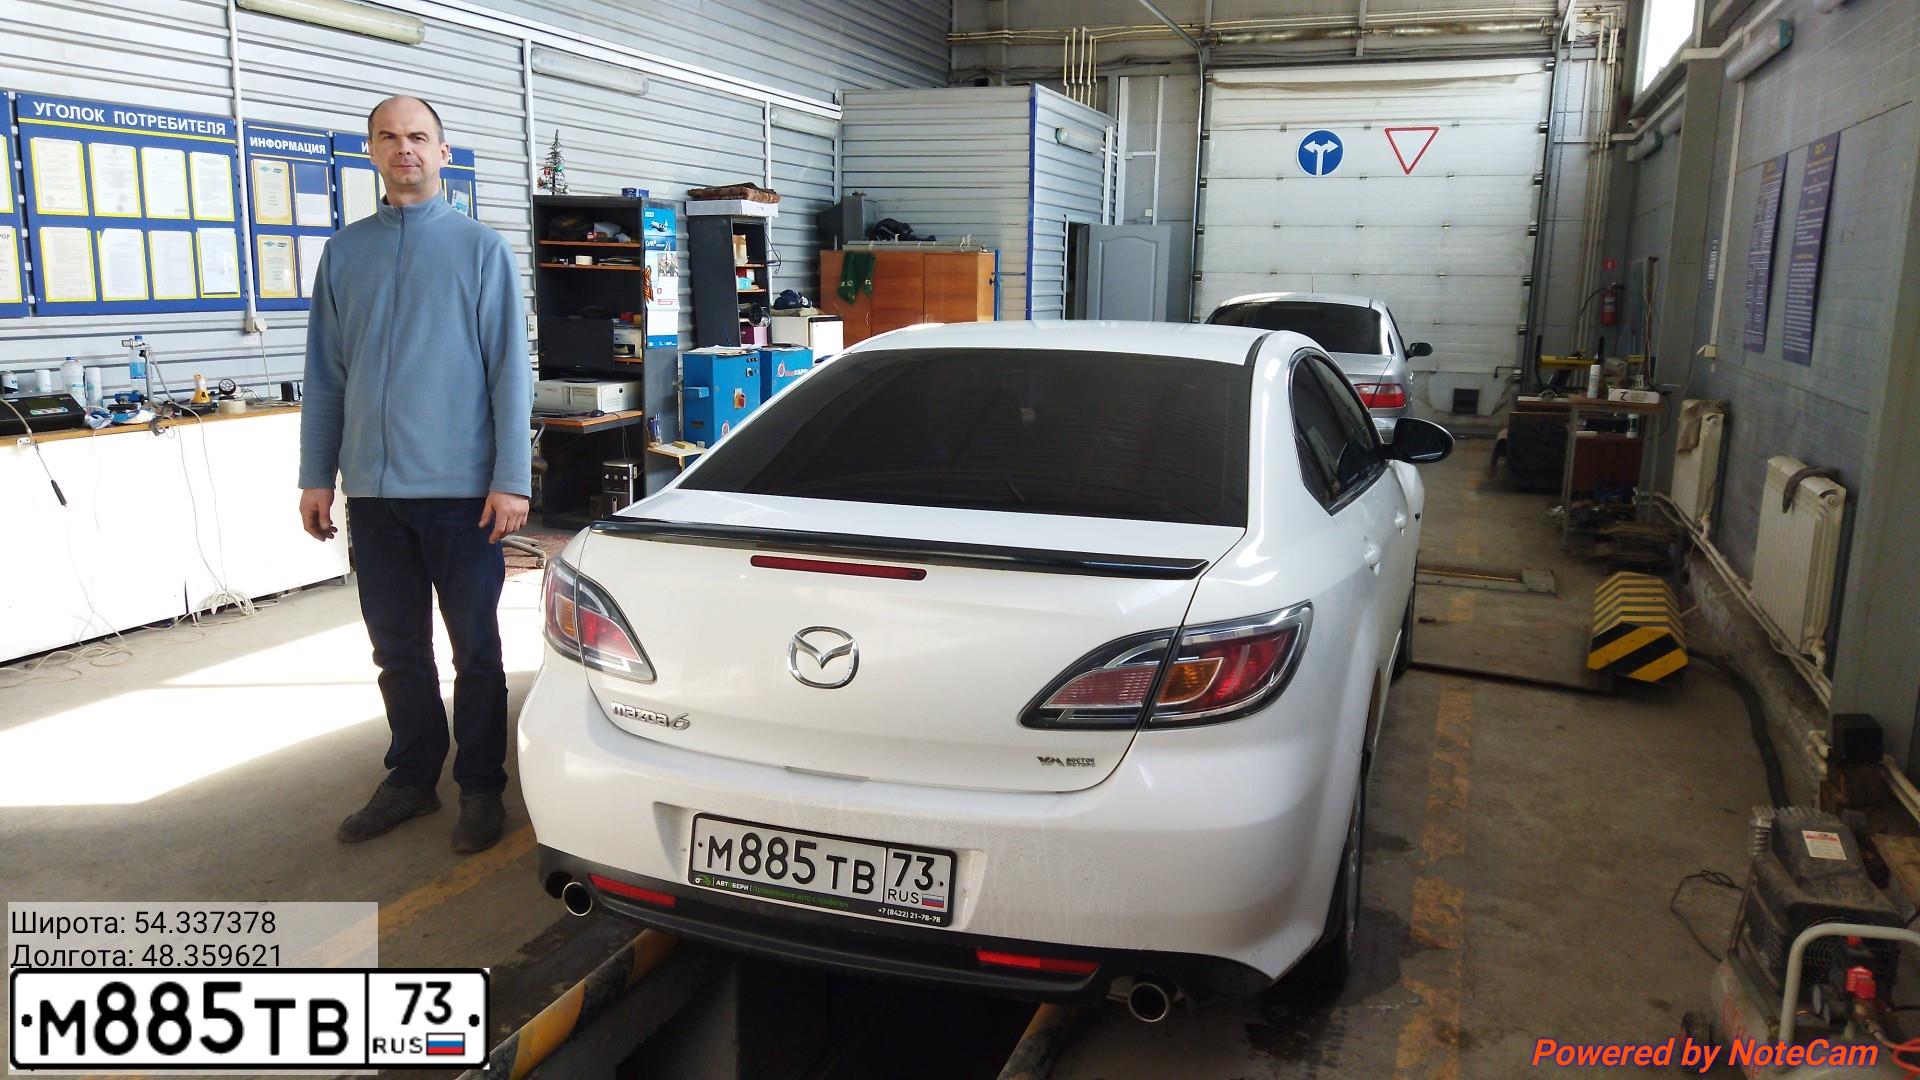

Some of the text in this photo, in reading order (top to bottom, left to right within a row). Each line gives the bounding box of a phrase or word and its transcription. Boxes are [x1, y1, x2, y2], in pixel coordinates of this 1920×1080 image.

[33, 101, 226, 136] УГОЛОК ПОТРЕБИТЕЛЯ
[249, 136, 326, 155] ИНФОРМАЦИЯ
[892, 852, 935, 891] 73
[887, 888, 920, 904] RUS
[888, 908, 909, 919] (8422)
[909, 912, 941, 923] 21-78-78
